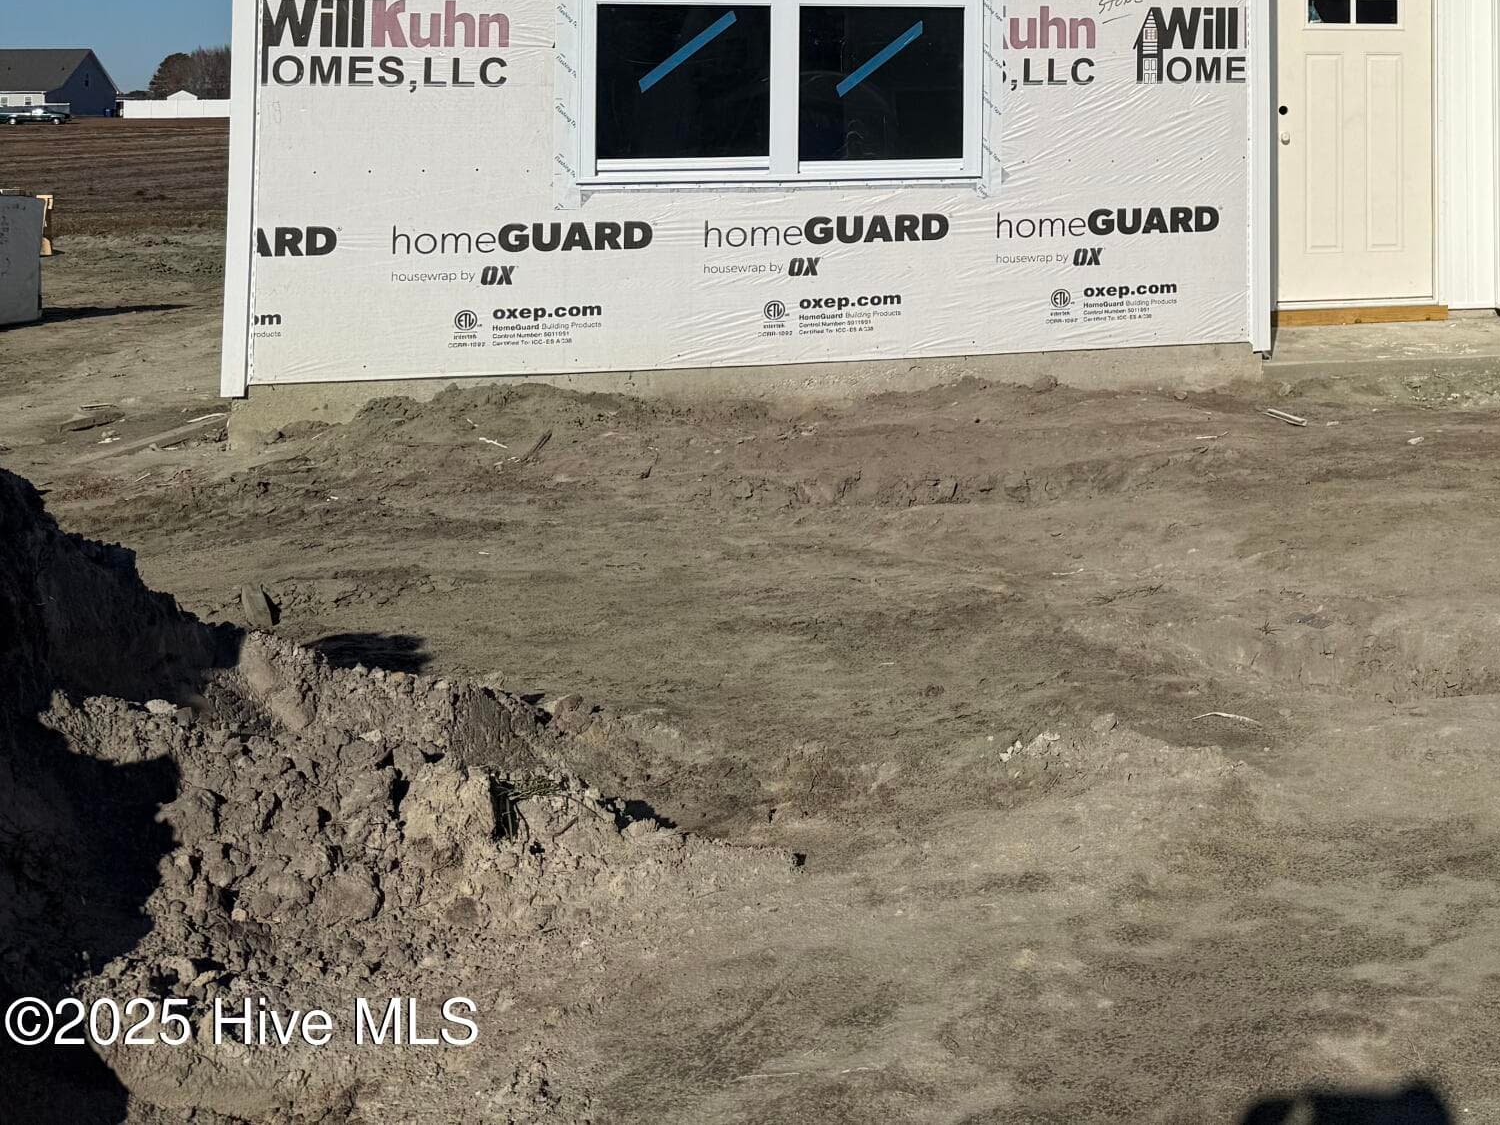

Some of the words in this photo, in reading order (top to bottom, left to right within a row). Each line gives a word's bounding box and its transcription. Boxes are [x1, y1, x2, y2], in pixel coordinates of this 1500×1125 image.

[1003, 5, 1096, 49] uhn
[1150, 6, 1247, 50] Will
[1003, 57, 1096, 91] ,LLC
[704, 214, 949, 248] homeGUARD
[996, 206, 1220, 239] homeGUARD
[392, 221, 653, 255] homeGUARD
[703, 263, 766, 274] housewrap
[769, 262, 784, 274] by
[788, 257, 821, 277] OX
[996, 254, 1053, 265] housewrap
[1056, 252, 1069, 264] by
[1072, 247, 1104, 267] OX
[391, 271, 457, 283] housewrap
[460, 270, 475, 283] by
[480, 265, 517, 286] OX
[1083, 283, 1177, 298] oxep.com
[800, 294, 902, 310] oxep.com
[493, 305, 602, 321] oxep.com
[799, 313, 843, 321] HomeGuard
[492, 324, 540, 332] HomeGuard
